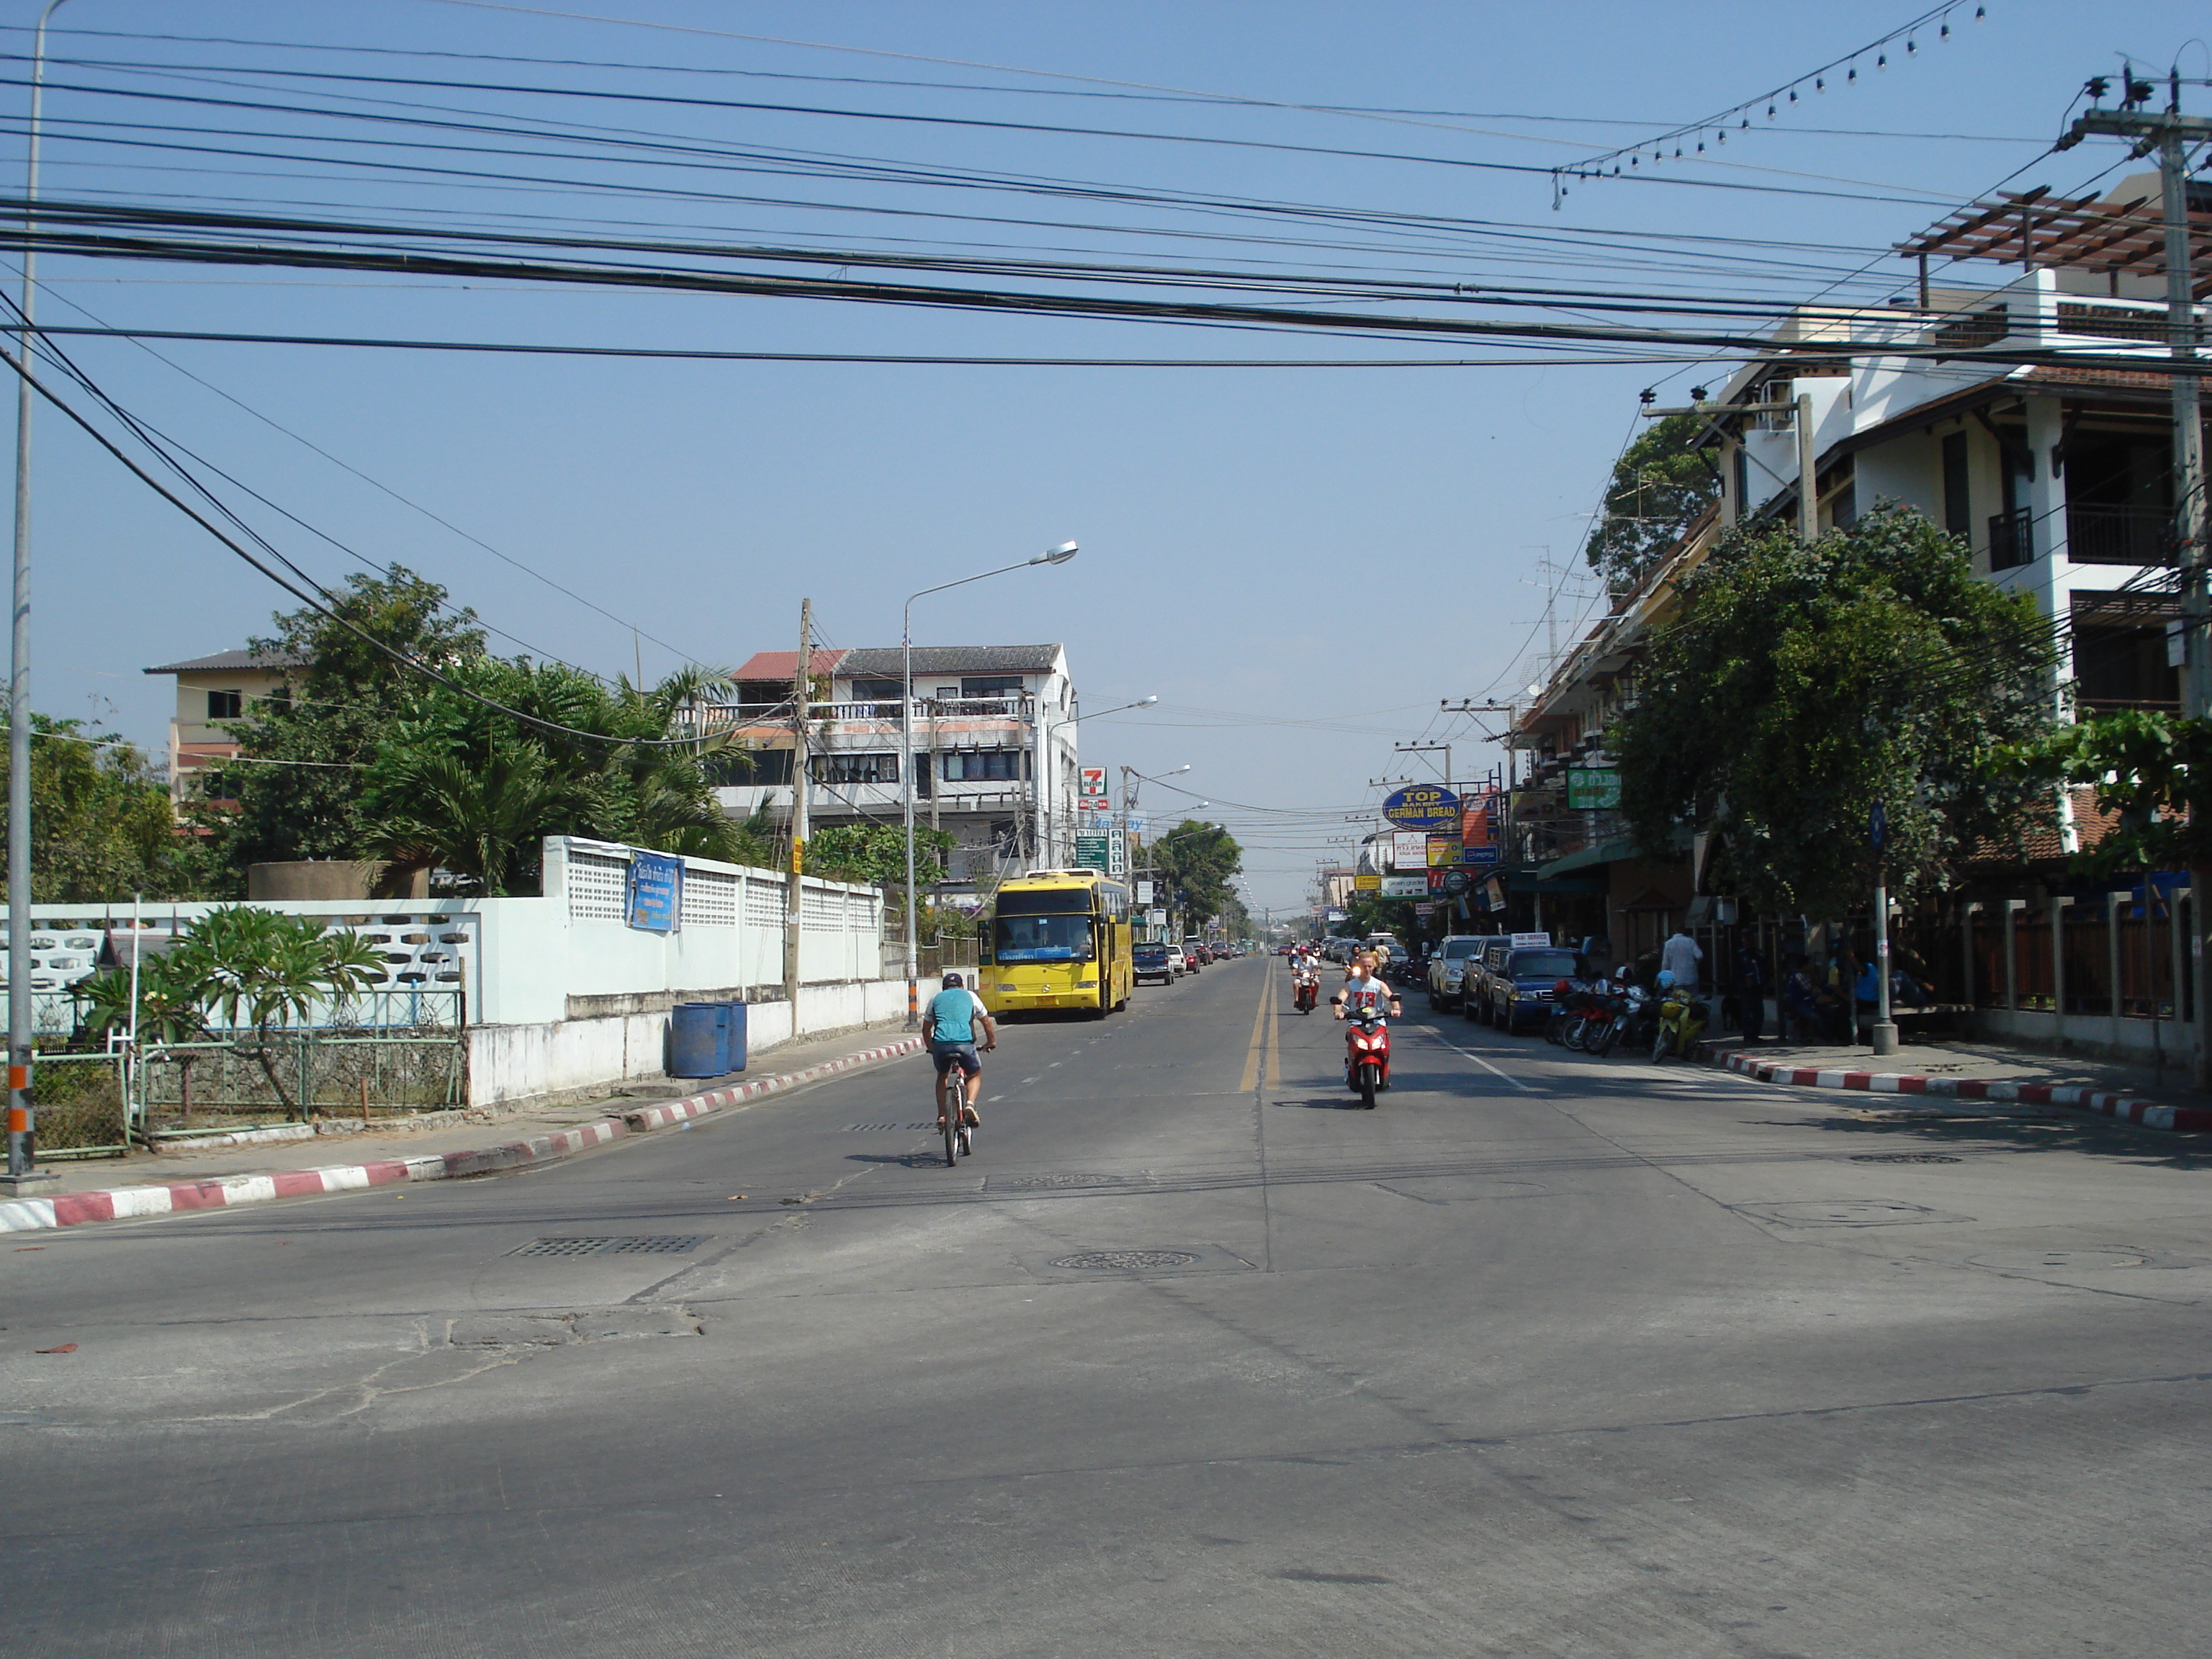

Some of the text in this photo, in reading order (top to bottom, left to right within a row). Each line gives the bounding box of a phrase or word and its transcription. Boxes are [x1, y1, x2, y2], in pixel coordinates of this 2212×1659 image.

[1084, 770, 1102, 793] 7
[1403, 791, 1442, 802] TOP
[1388, 807, 1424, 819] GERMAN
[1426, 806, 1455, 818] BREAD
[1354, 992, 1376, 1007] 73
